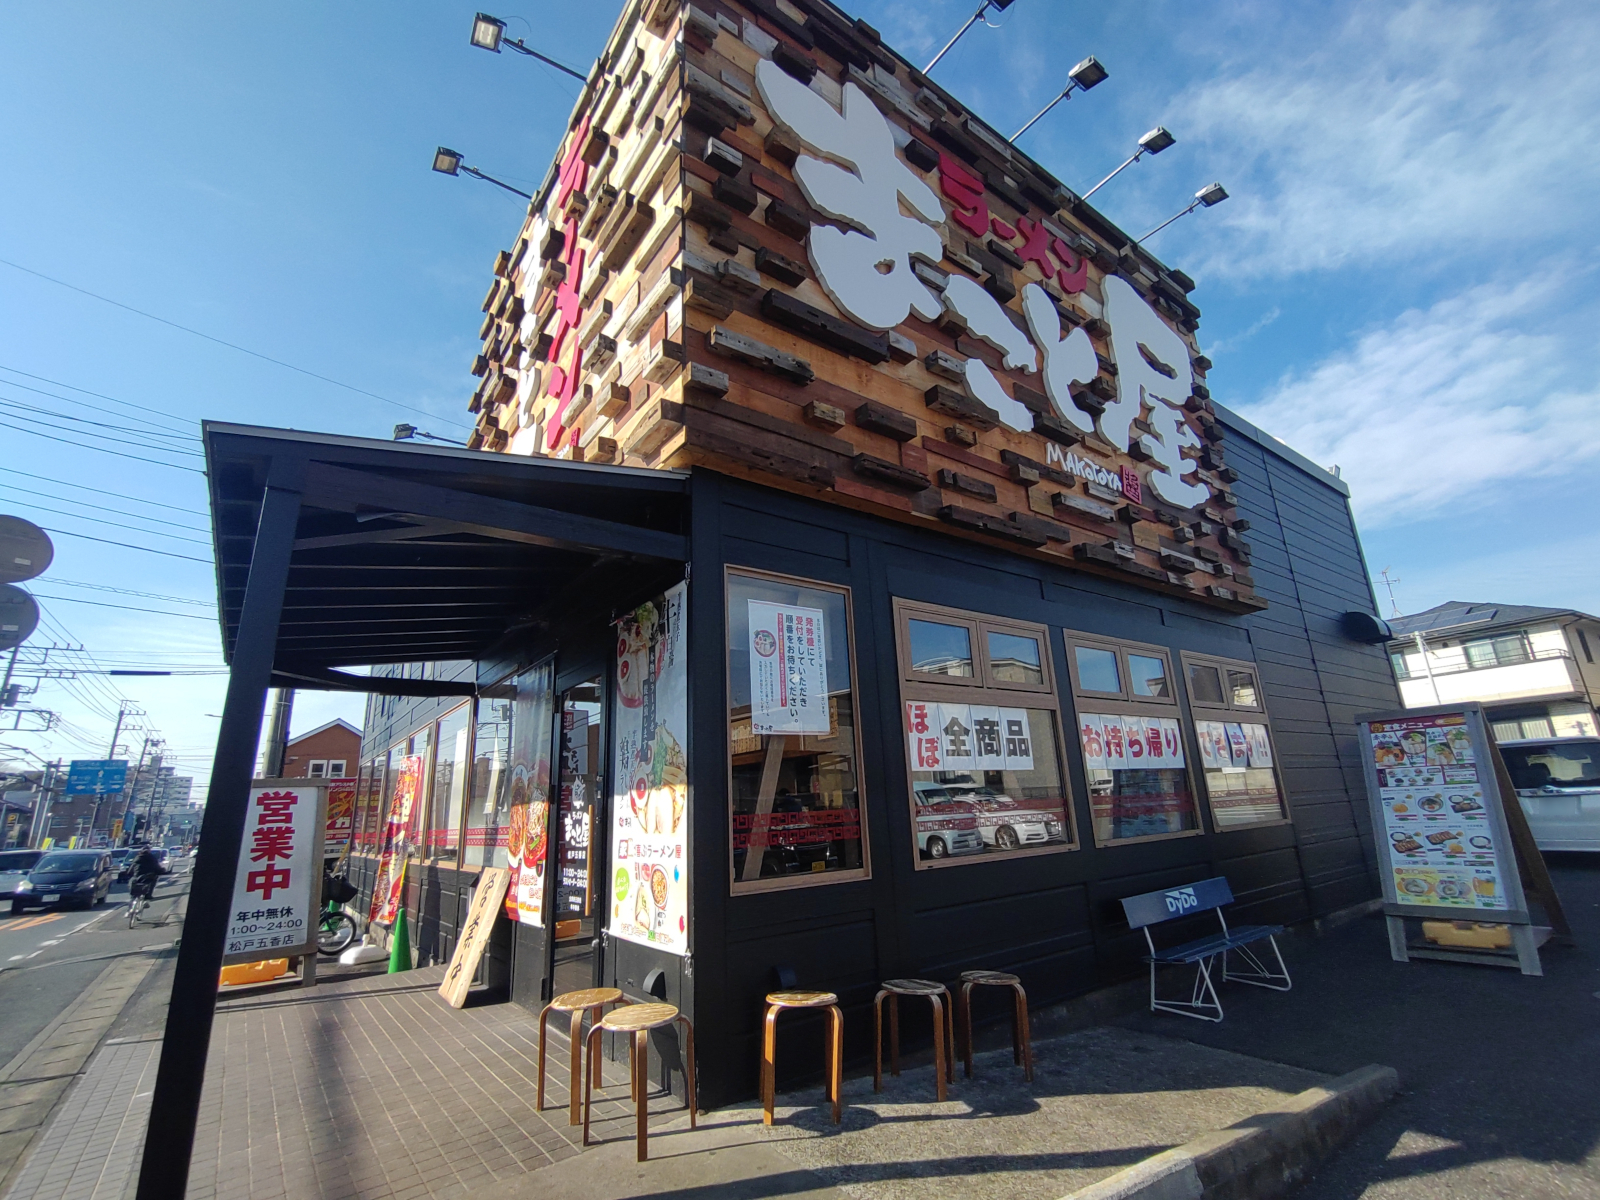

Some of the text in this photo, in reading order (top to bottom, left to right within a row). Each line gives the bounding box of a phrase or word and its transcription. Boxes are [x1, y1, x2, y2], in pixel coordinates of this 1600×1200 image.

[938, 153, 1088, 295] ラーメン
[755, 57, 1211, 509] まこと屋
[785, 614, 799, 723] 順番をお待ちください。
[795, 615, 808, 708] 受付をしていただき
[805, 617, 815, 667] 発券機にて
[908, 704, 1031, 768] ほぼ 全商品
[1082, 724, 1178, 759] お持ち帰り
[246, 791, 299, 901] 営業中
[236, 906, 294, 922] 年中無休
[1165, 894, 1198, 914] DyDo
[229, 934, 294, 952] 松戸五香店
